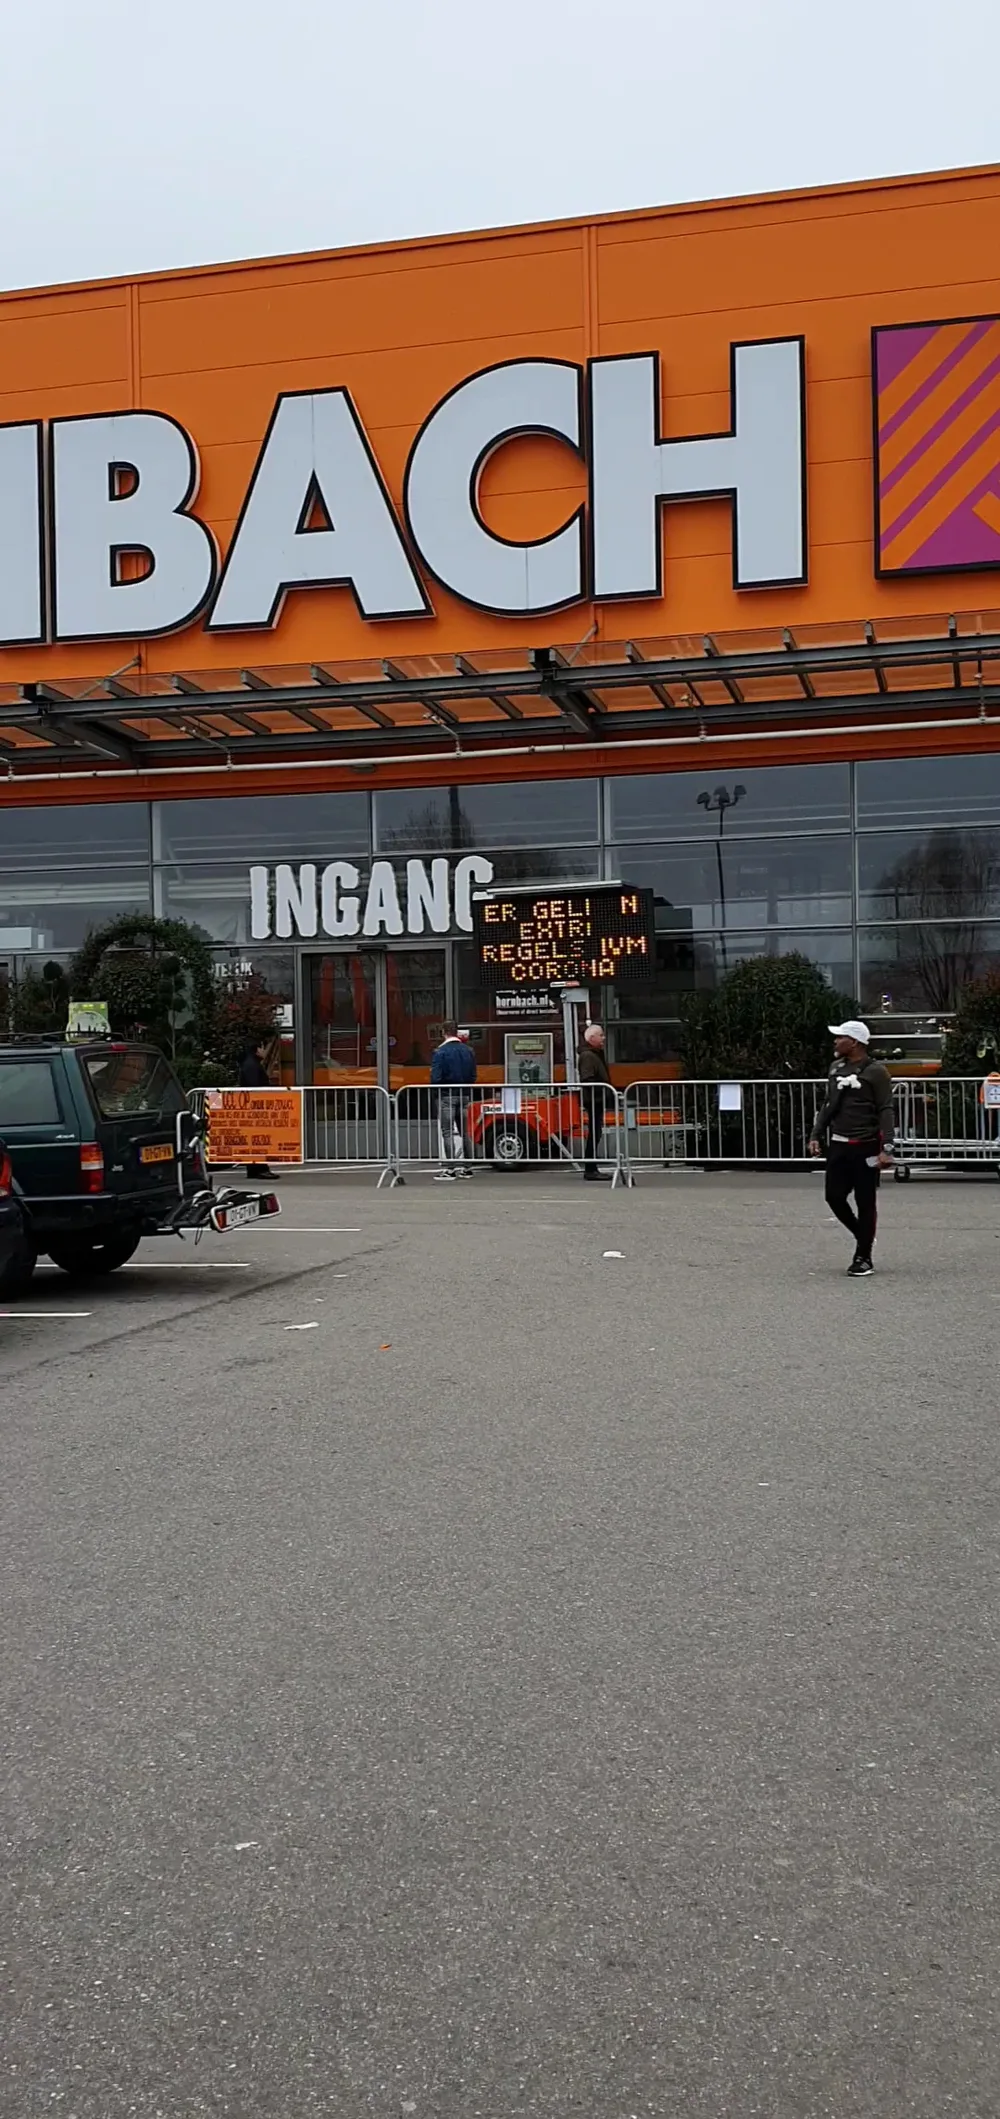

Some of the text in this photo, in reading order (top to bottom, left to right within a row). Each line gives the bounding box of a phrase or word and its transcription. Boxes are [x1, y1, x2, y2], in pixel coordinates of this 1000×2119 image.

[0, 334, 808, 644] BACH
[484, 903, 517, 922] ER
[601, 936, 647, 956] IVM
[511, 958, 615, 981] CORONA
[496, 994, 549, 1008] hornbach.nl
